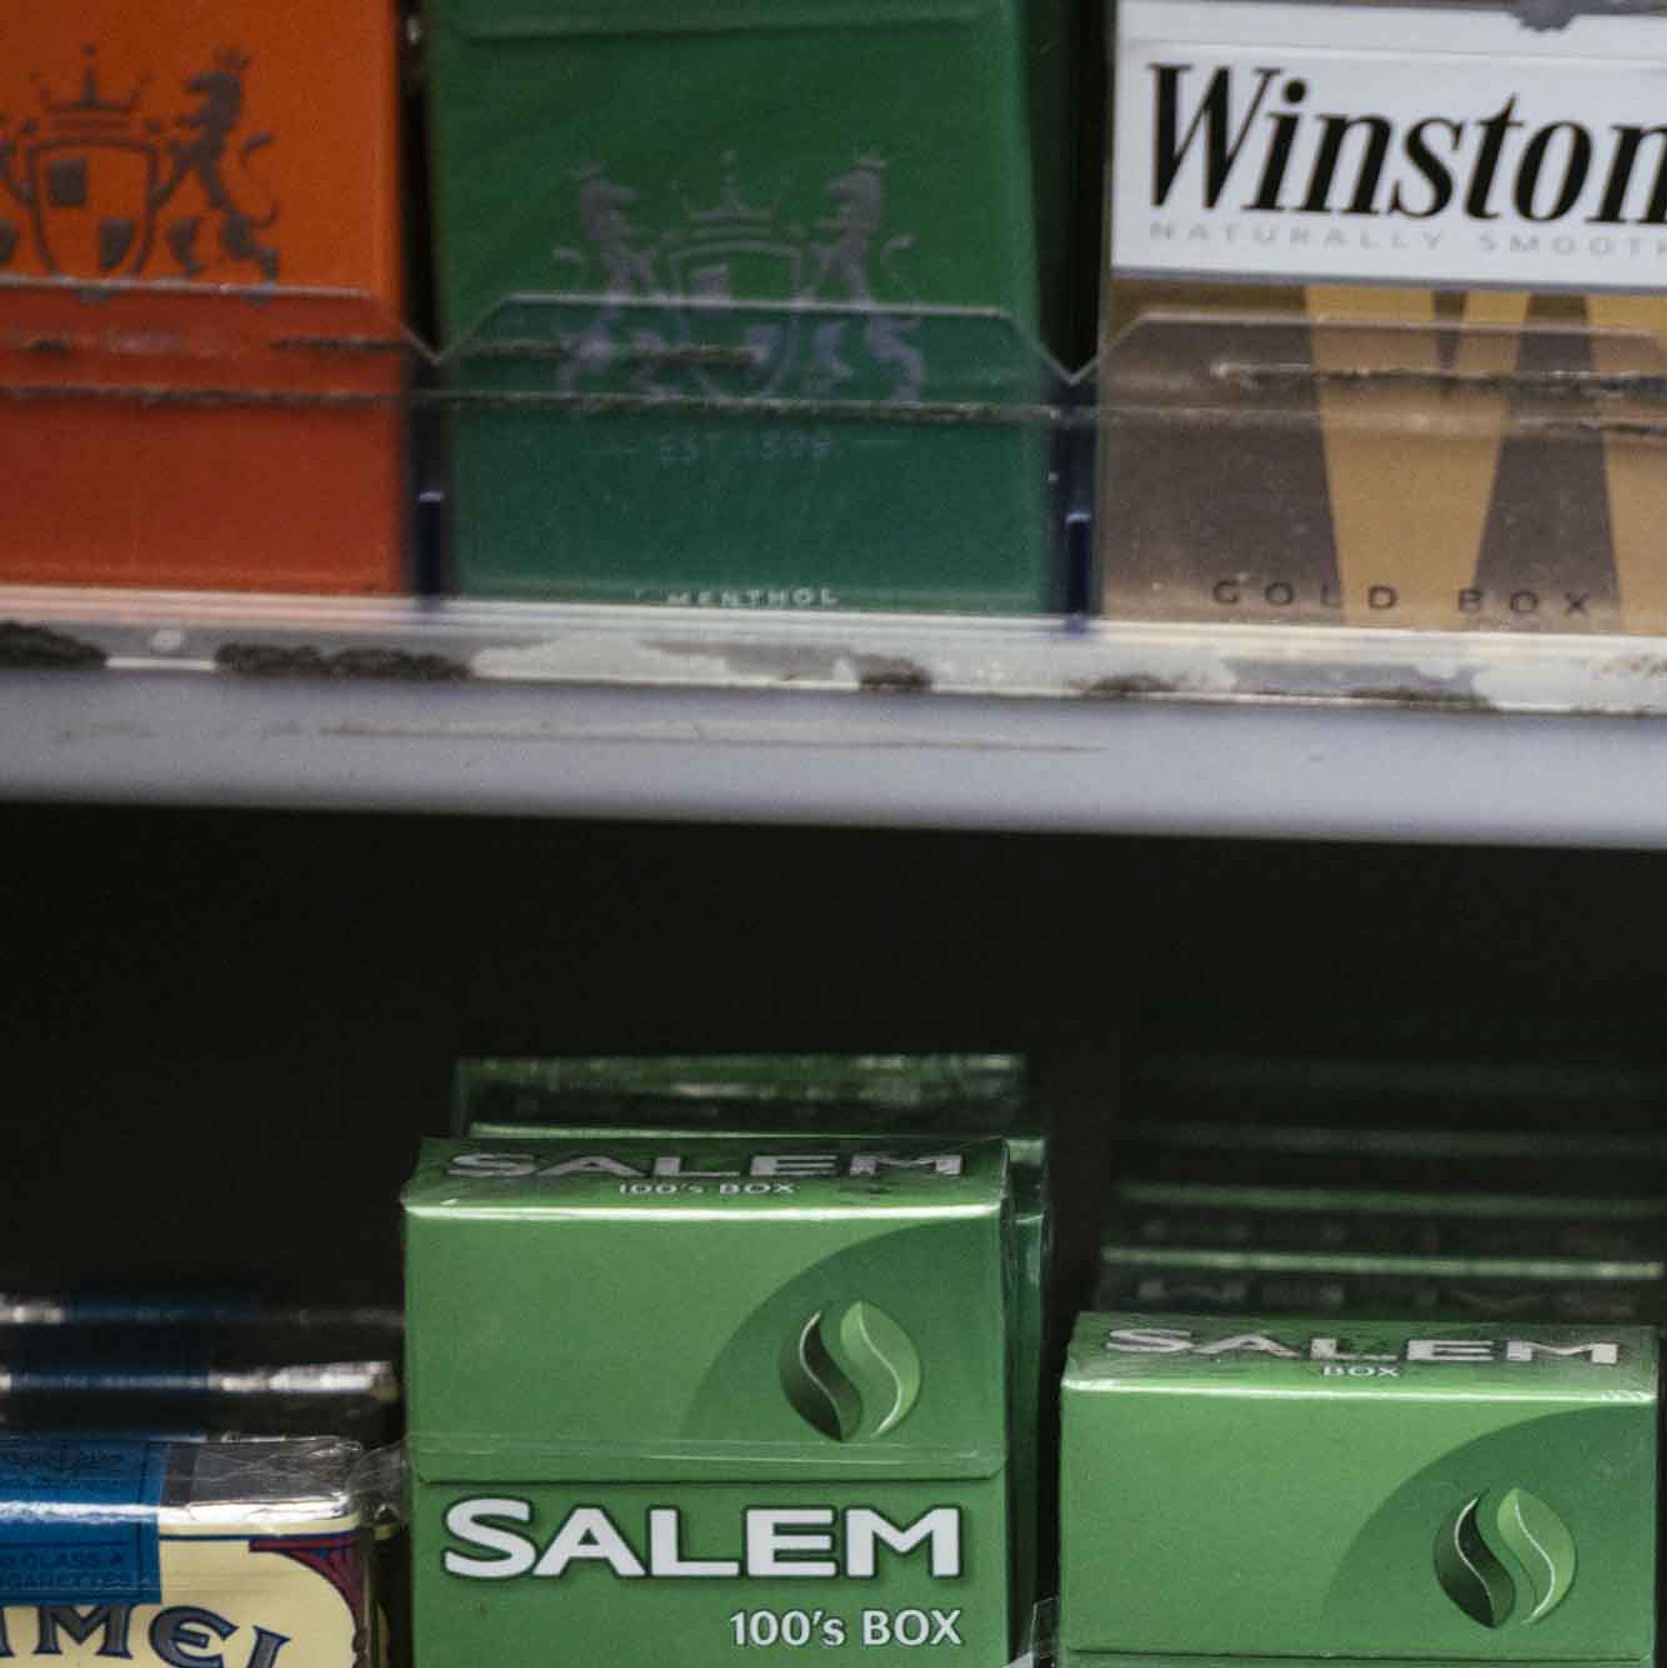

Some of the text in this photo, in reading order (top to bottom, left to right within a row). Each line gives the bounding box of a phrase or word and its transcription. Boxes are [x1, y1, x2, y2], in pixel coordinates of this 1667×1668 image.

[1149, 221, 1443, 252] NATURALLY
[1211, 580, 1591, 616] GOLD BOX
[447, 1152, 965, 1180] SALEM
[718, 1183, 798, 1195] BOX
[1105, 1327, 1619, 1365] SALEM
[1322, 1365, 1402, 1378] BOX
[442, 1496, 962, 1579] SALEM
[730, 1609, 963, 1648] 100's BOX
